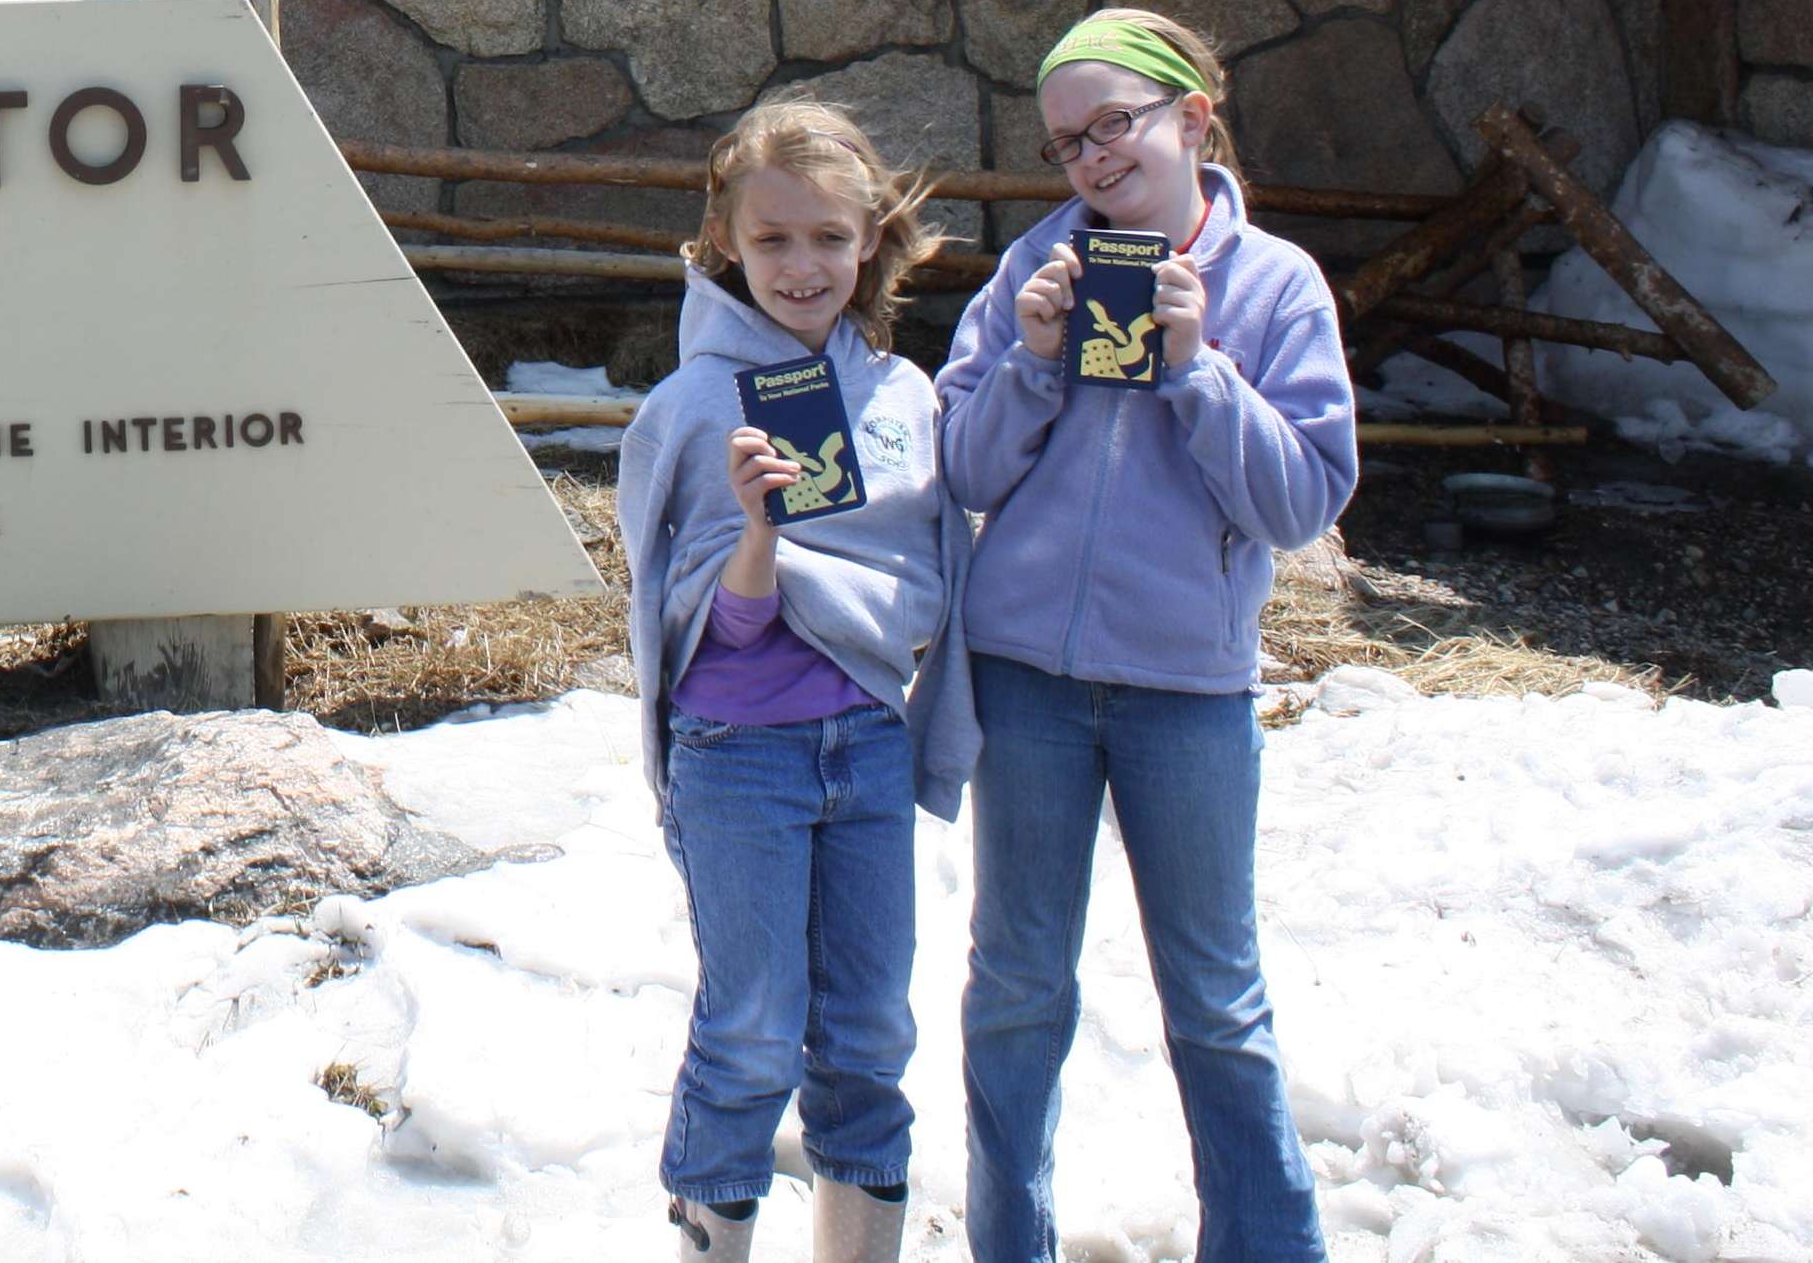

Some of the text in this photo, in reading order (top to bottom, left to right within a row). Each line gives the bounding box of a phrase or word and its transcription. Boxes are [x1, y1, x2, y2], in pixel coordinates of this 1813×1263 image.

[1088, 238, 1161, 256] Passport
[754, 362, 827, 390] Passport
[82, 410, 306, 455] INTERIOR
